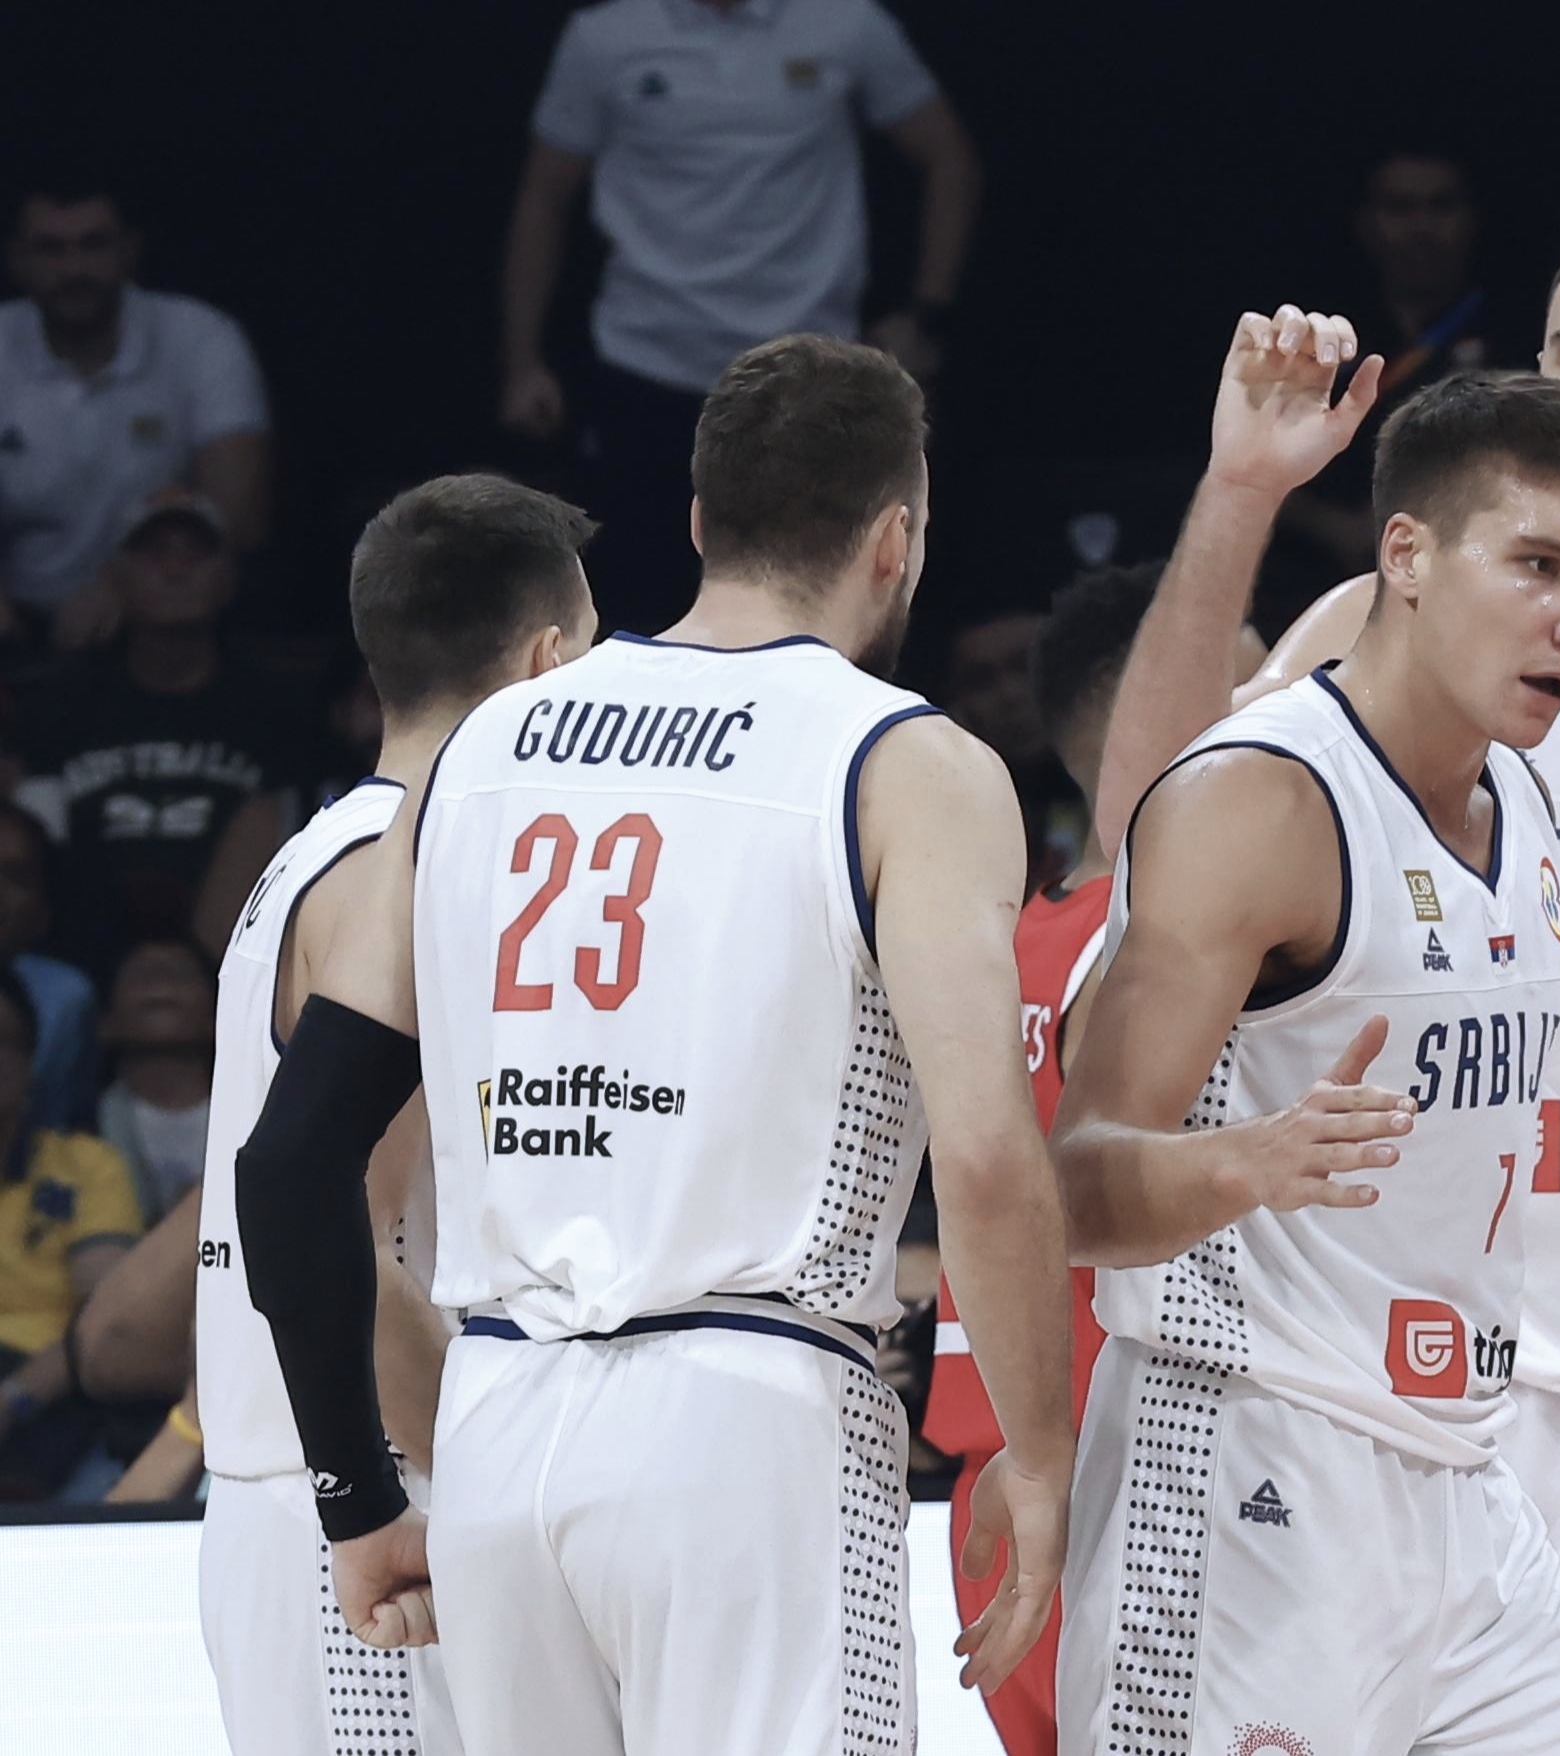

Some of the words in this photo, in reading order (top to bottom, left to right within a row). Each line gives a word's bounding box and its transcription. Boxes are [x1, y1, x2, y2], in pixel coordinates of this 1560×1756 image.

[514, 699, 757, 772] GUDURIĆ
[493, 813, 663, 1012] 23
[497, 1064, 686, 1116] Raiffeisen
[1409, 1012, 1560, 1113] SRBIJ
[493, 1114, 613, 1158] Bank
[1484, 1153, 1516, 1254] 7
[1239, 1501, 1294, 1528] PEAK
